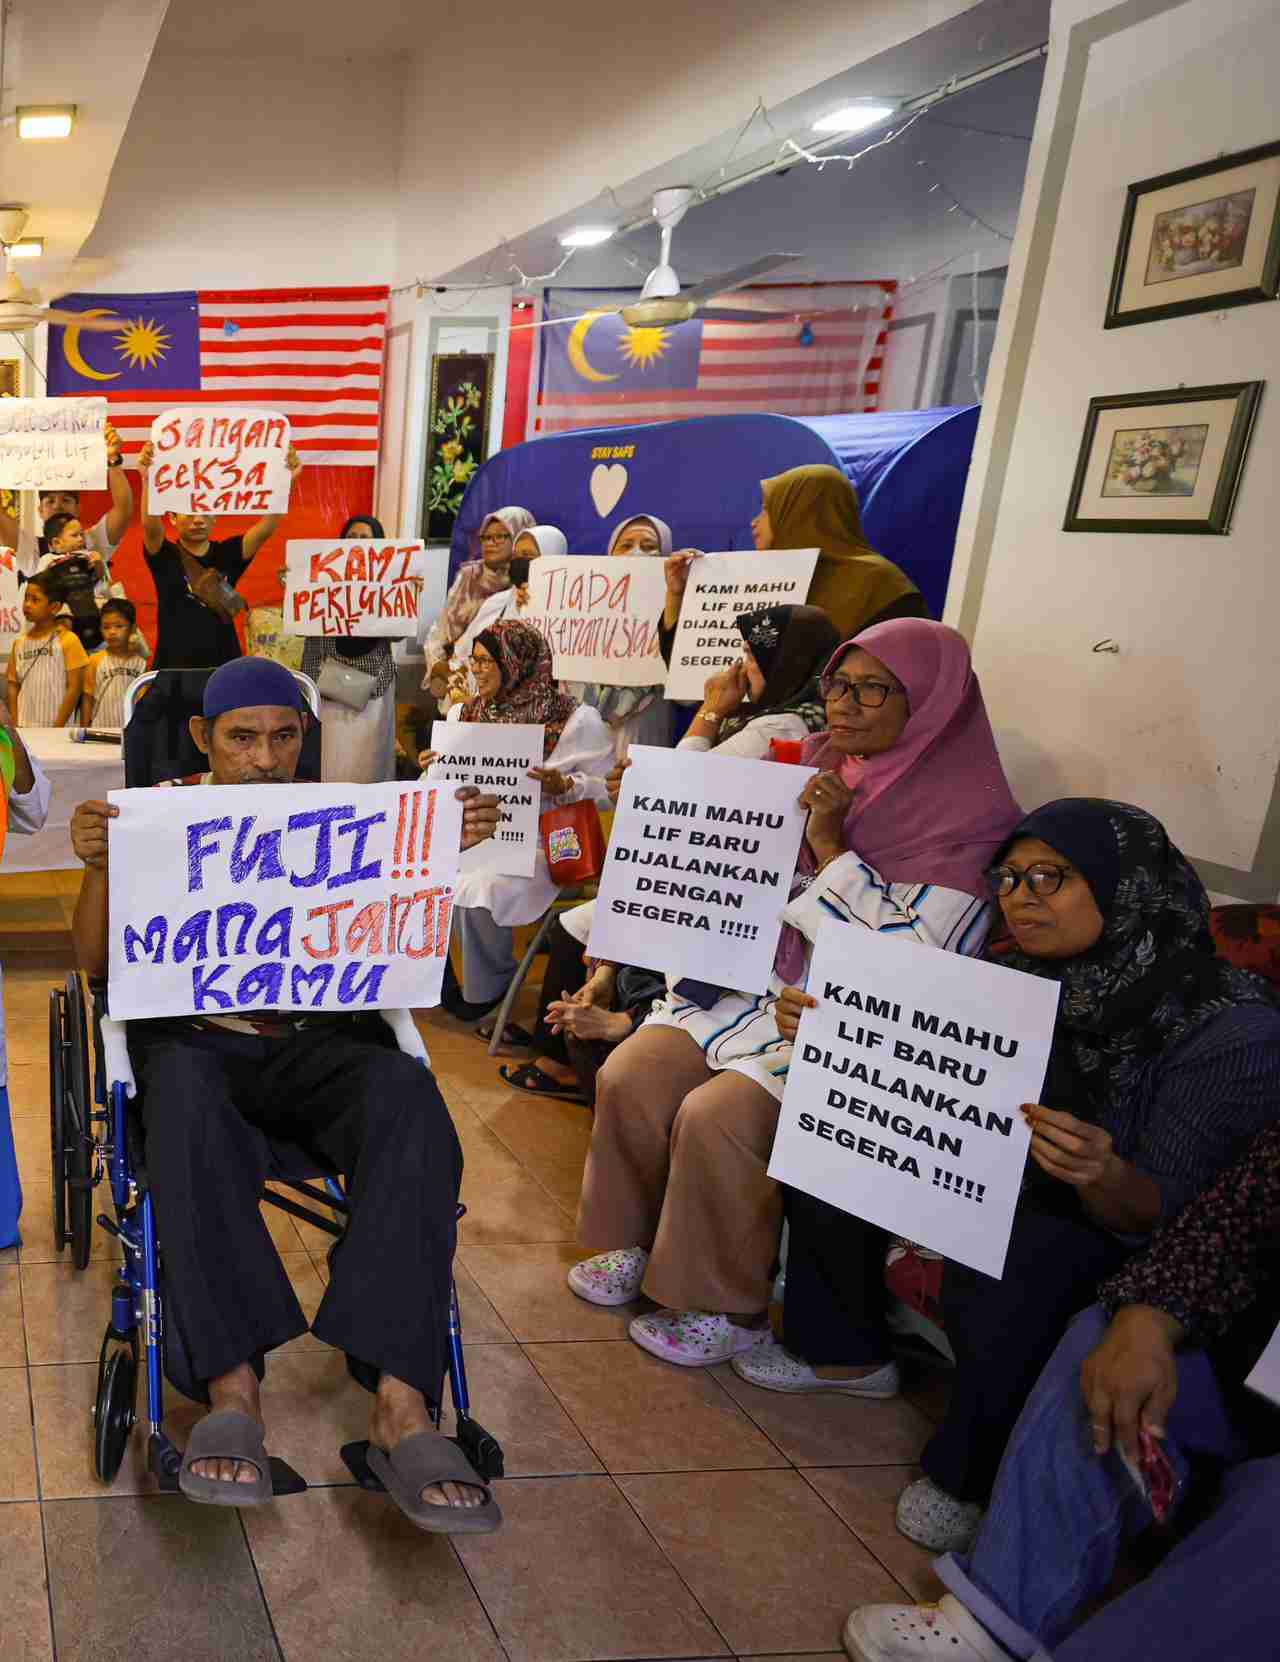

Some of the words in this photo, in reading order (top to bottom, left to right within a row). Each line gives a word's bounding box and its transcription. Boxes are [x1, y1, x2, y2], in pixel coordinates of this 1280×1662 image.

[310, 545, 423, 584] KAMI
[695, 583, 739, 595] KAMI
[743, 581, 797, 594] MAHU
[701, 602, 729, 612] LIF
[322, 616, 360, 637] LIF
[682, 619, 740, 630] DIJALA
[696, 637, 743, 648] DENG
[436, 754, 476, 767] KAMI
[481, 755, 530, 770] MAHU
[474, 774, 518, 787] BARU
[632, 795, 697, 818] KAMI
[705, 806, 784, 830] MAHU
[642, 825, 681, 841] LIF
[688, 831, 761, 854] BARU
[613, 847, 780, 887] DIJALANKAN
[636, 877, 744, 909] DENGAN
[611, 899, 711, 931] SEGERA
[719, 919, 760, 940] !!!!!
[823, 982, 902, 1023] KAMI
[911, 1010, 1019, 1058] MAHU
[837, 1021, 884, 1049] LIF
[893, 1039, 988, 1087] BARU
[802, 1043, 1014, 1137] DIJALANKAN
[826, 1088, 963, 1157] DENGAN
[798, 1112, 921, 1178] SEGERA
[932, 1167, 987, 1203] !!!!!
